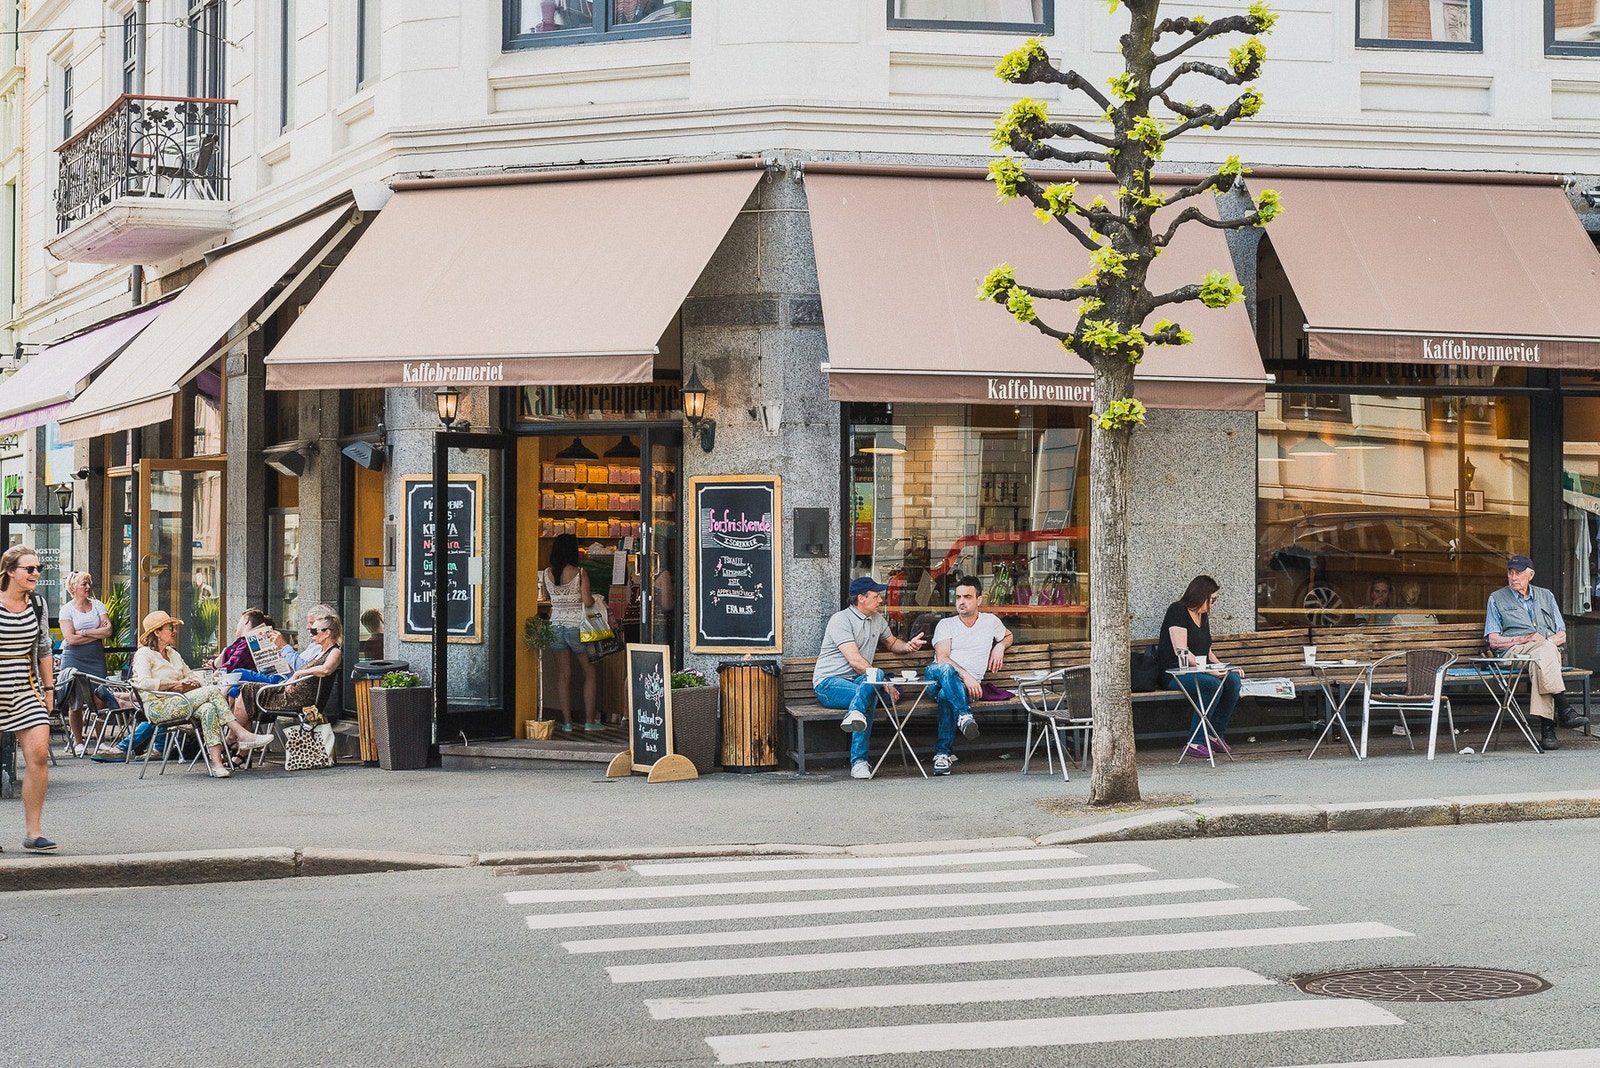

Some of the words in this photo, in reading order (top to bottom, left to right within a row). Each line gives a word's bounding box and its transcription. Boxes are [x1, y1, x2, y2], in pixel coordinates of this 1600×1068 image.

[1422, 339, 1541, 363] Kaffebrenneriet
[402, 361, 504, 384] Kaffebrenneriet
[987, 378, 1094, 401] Kaffebrenneri
